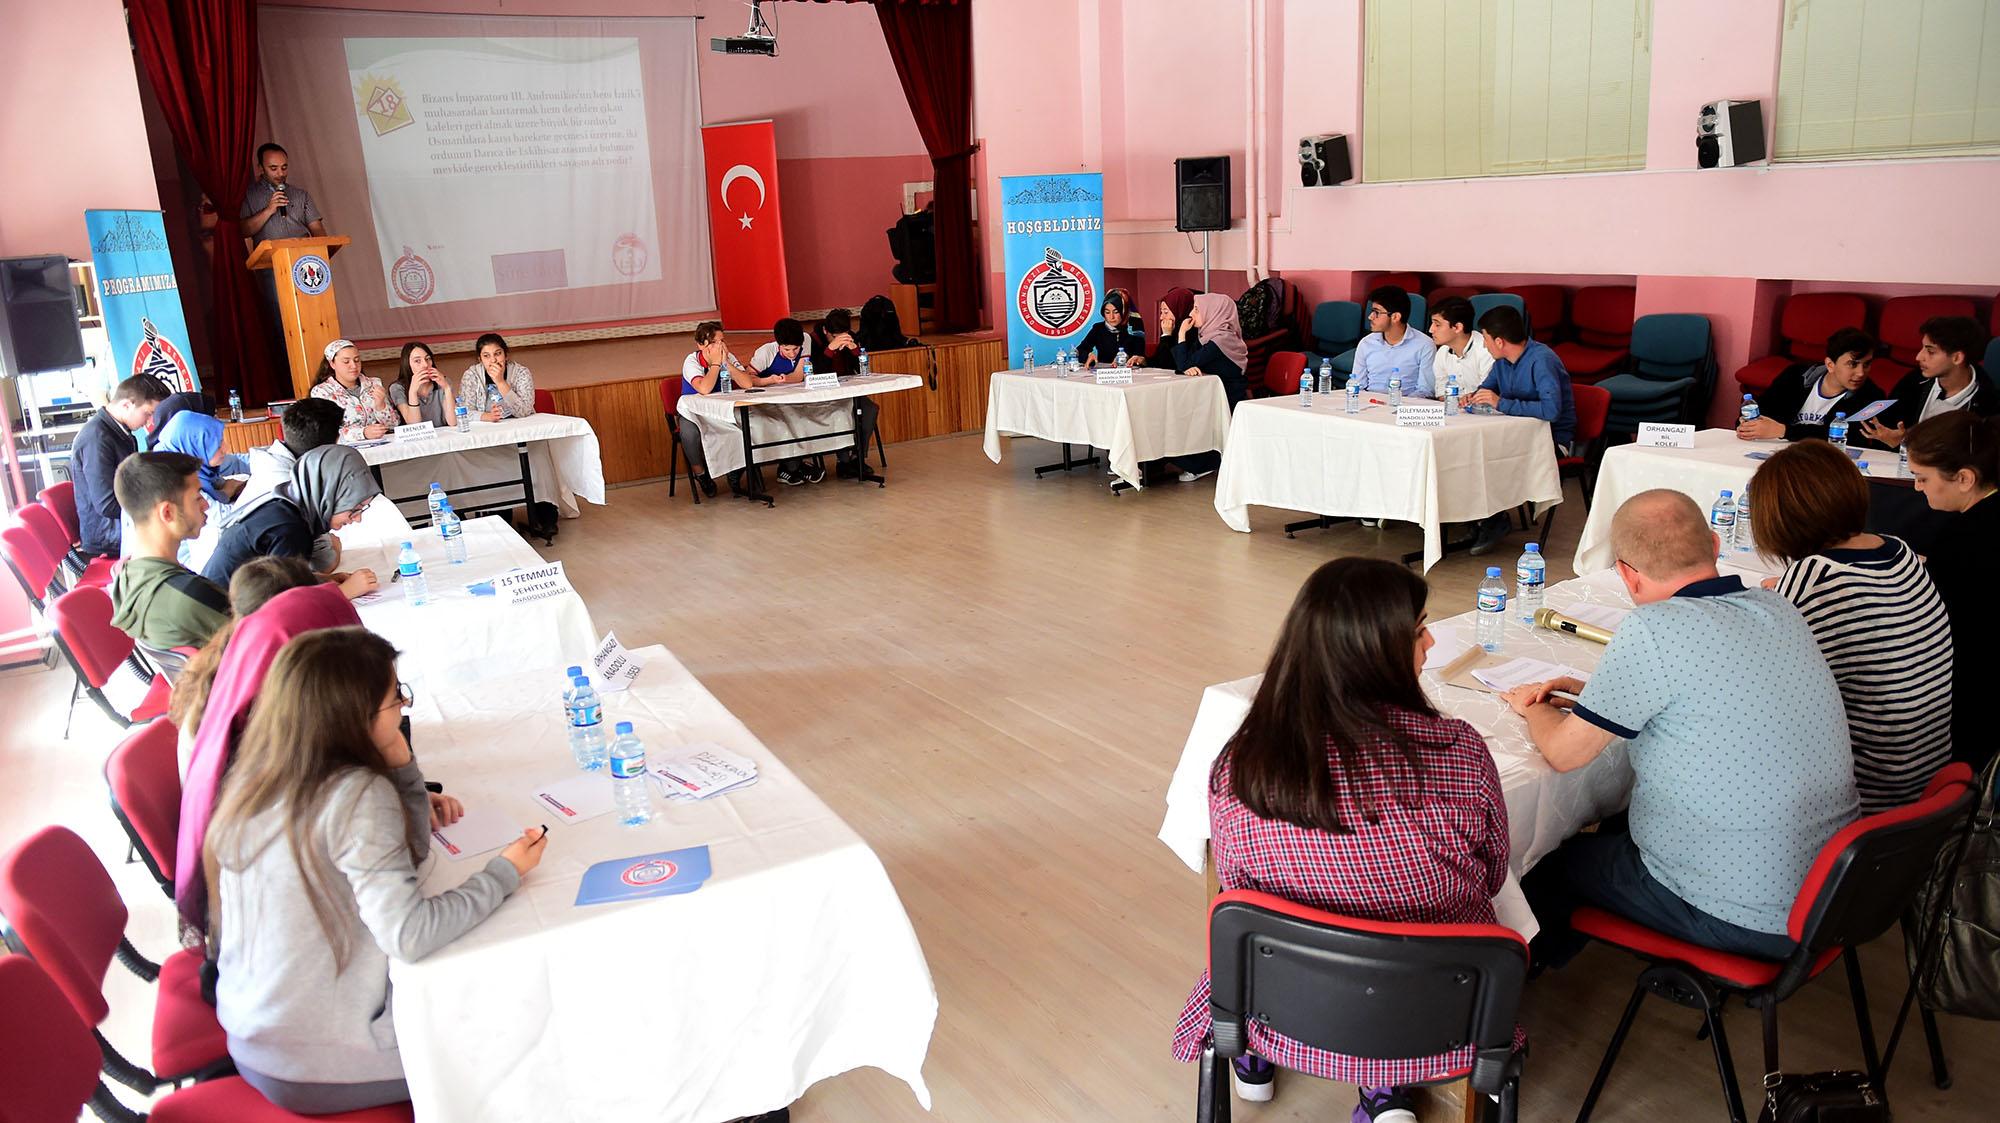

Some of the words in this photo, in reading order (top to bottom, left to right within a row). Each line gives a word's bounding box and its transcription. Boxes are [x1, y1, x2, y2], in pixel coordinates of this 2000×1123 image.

[377, 94, 397, 114] 18
[422, 93, 454, 103] Bizans
[490, 105, 539, 116] kurtarmak
[426, 121, 463, 131] kaleleri
[464, 121, 482, 132] geri
[482, 119, 512, 129] almak
[430, 149, 472, 160] ordunun
[1007, 215, 1101, 237] HOŞGELDİNİZ
[501, 577, 513, 587] 15
[514, 566, 559, 583] TEMMUZ
[512, 580, 557, 596] ŞEHİTLER
[603, 654, 627, 680] ANADOLU
